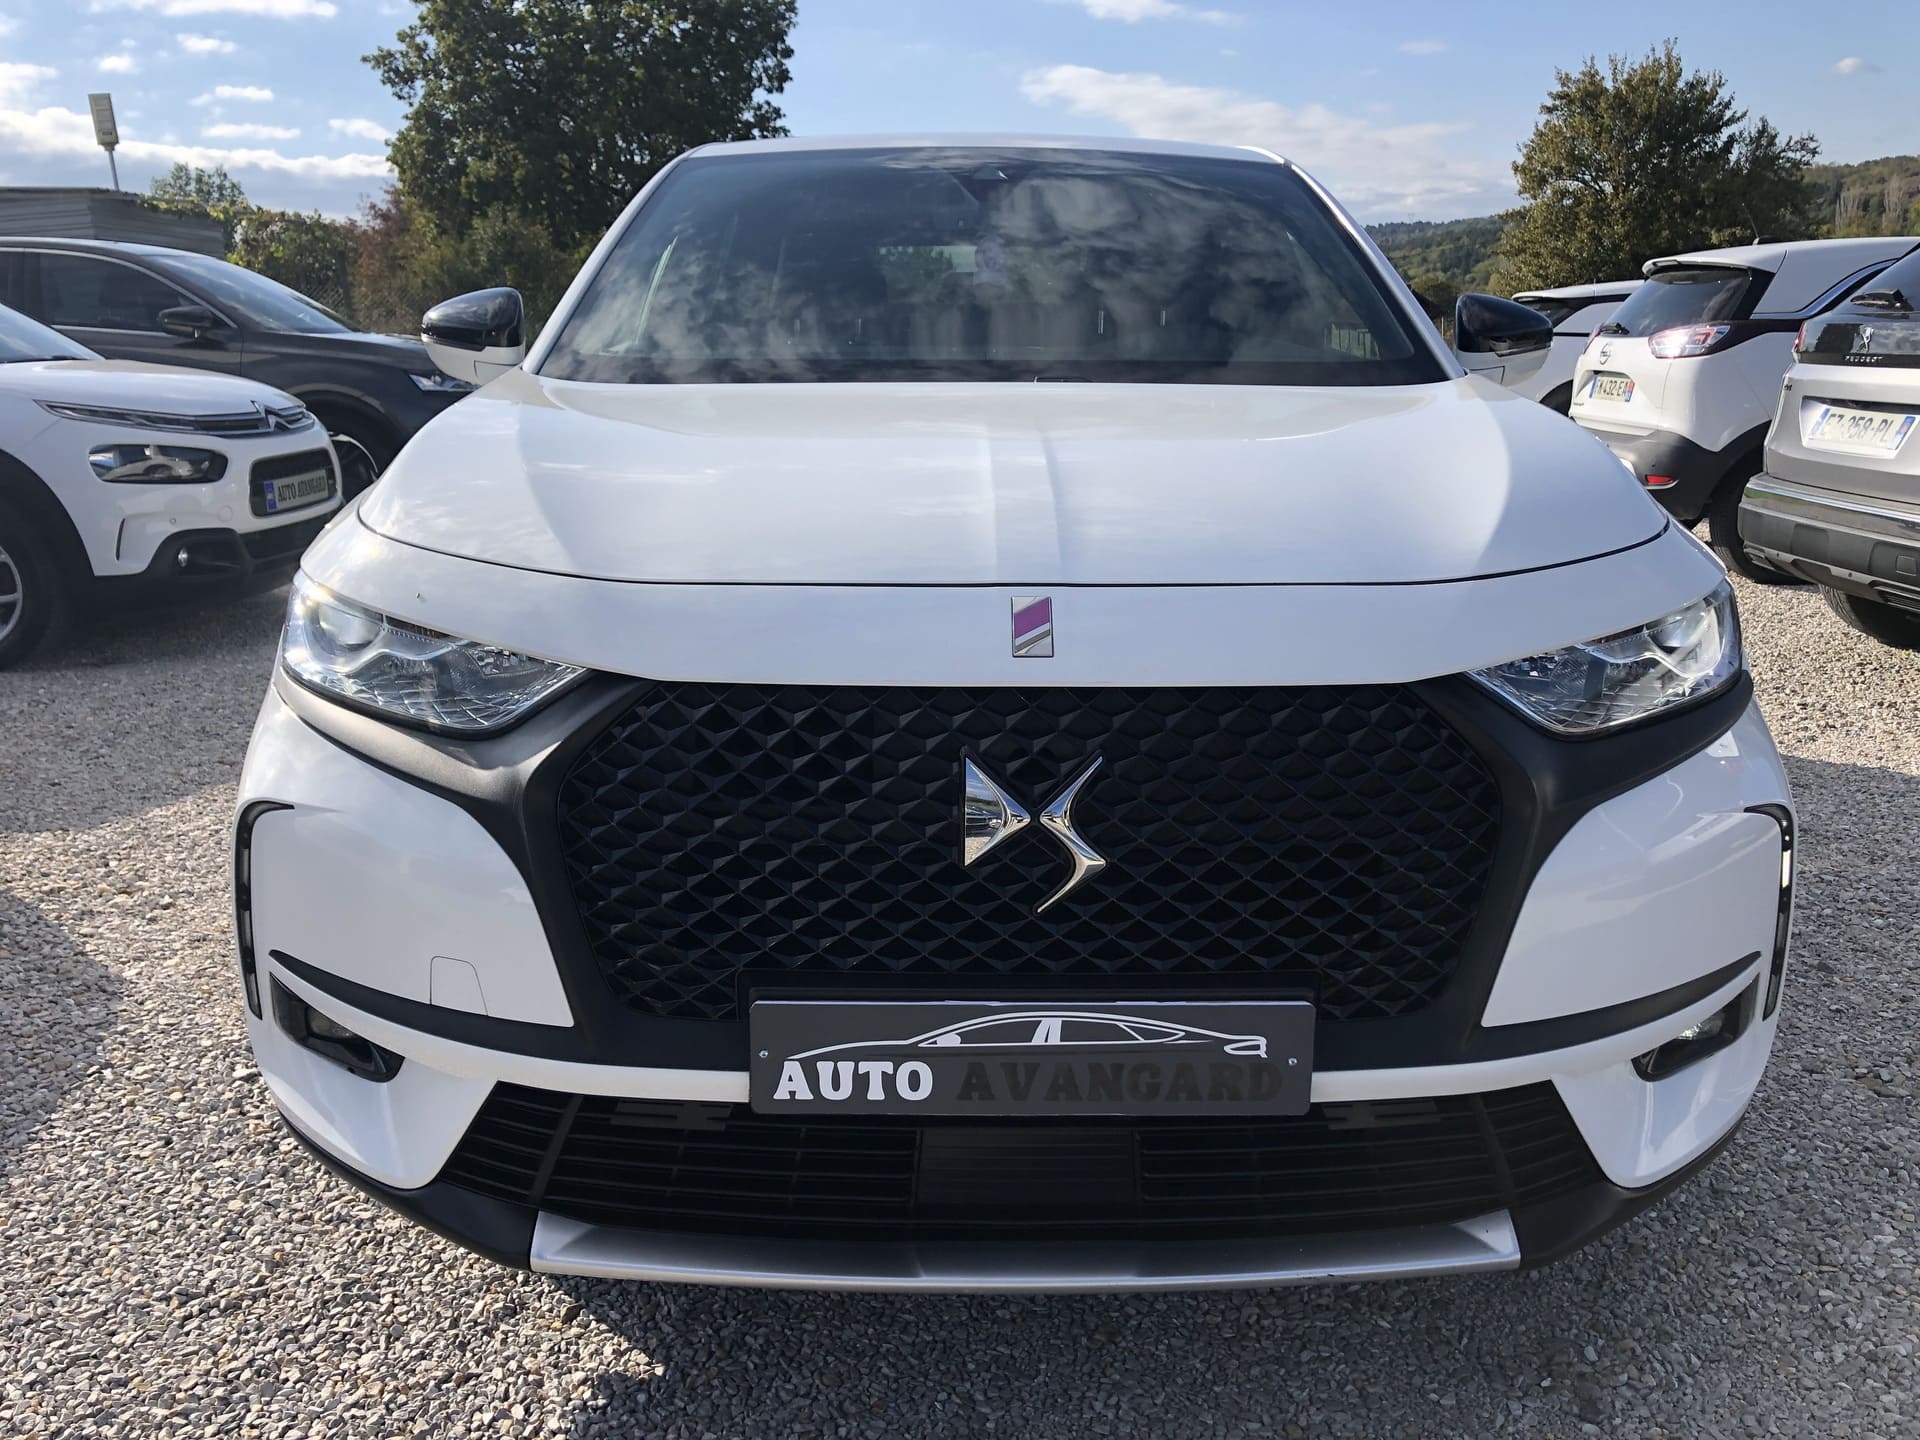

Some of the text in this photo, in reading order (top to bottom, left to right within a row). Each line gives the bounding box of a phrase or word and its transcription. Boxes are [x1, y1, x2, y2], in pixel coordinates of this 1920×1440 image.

[1844, 355, 1883, 363] PEUGEOT
[278, 482, 297, 502] AUTO
[773, 1060, 1283, 1102] AUTO AVANGARD
